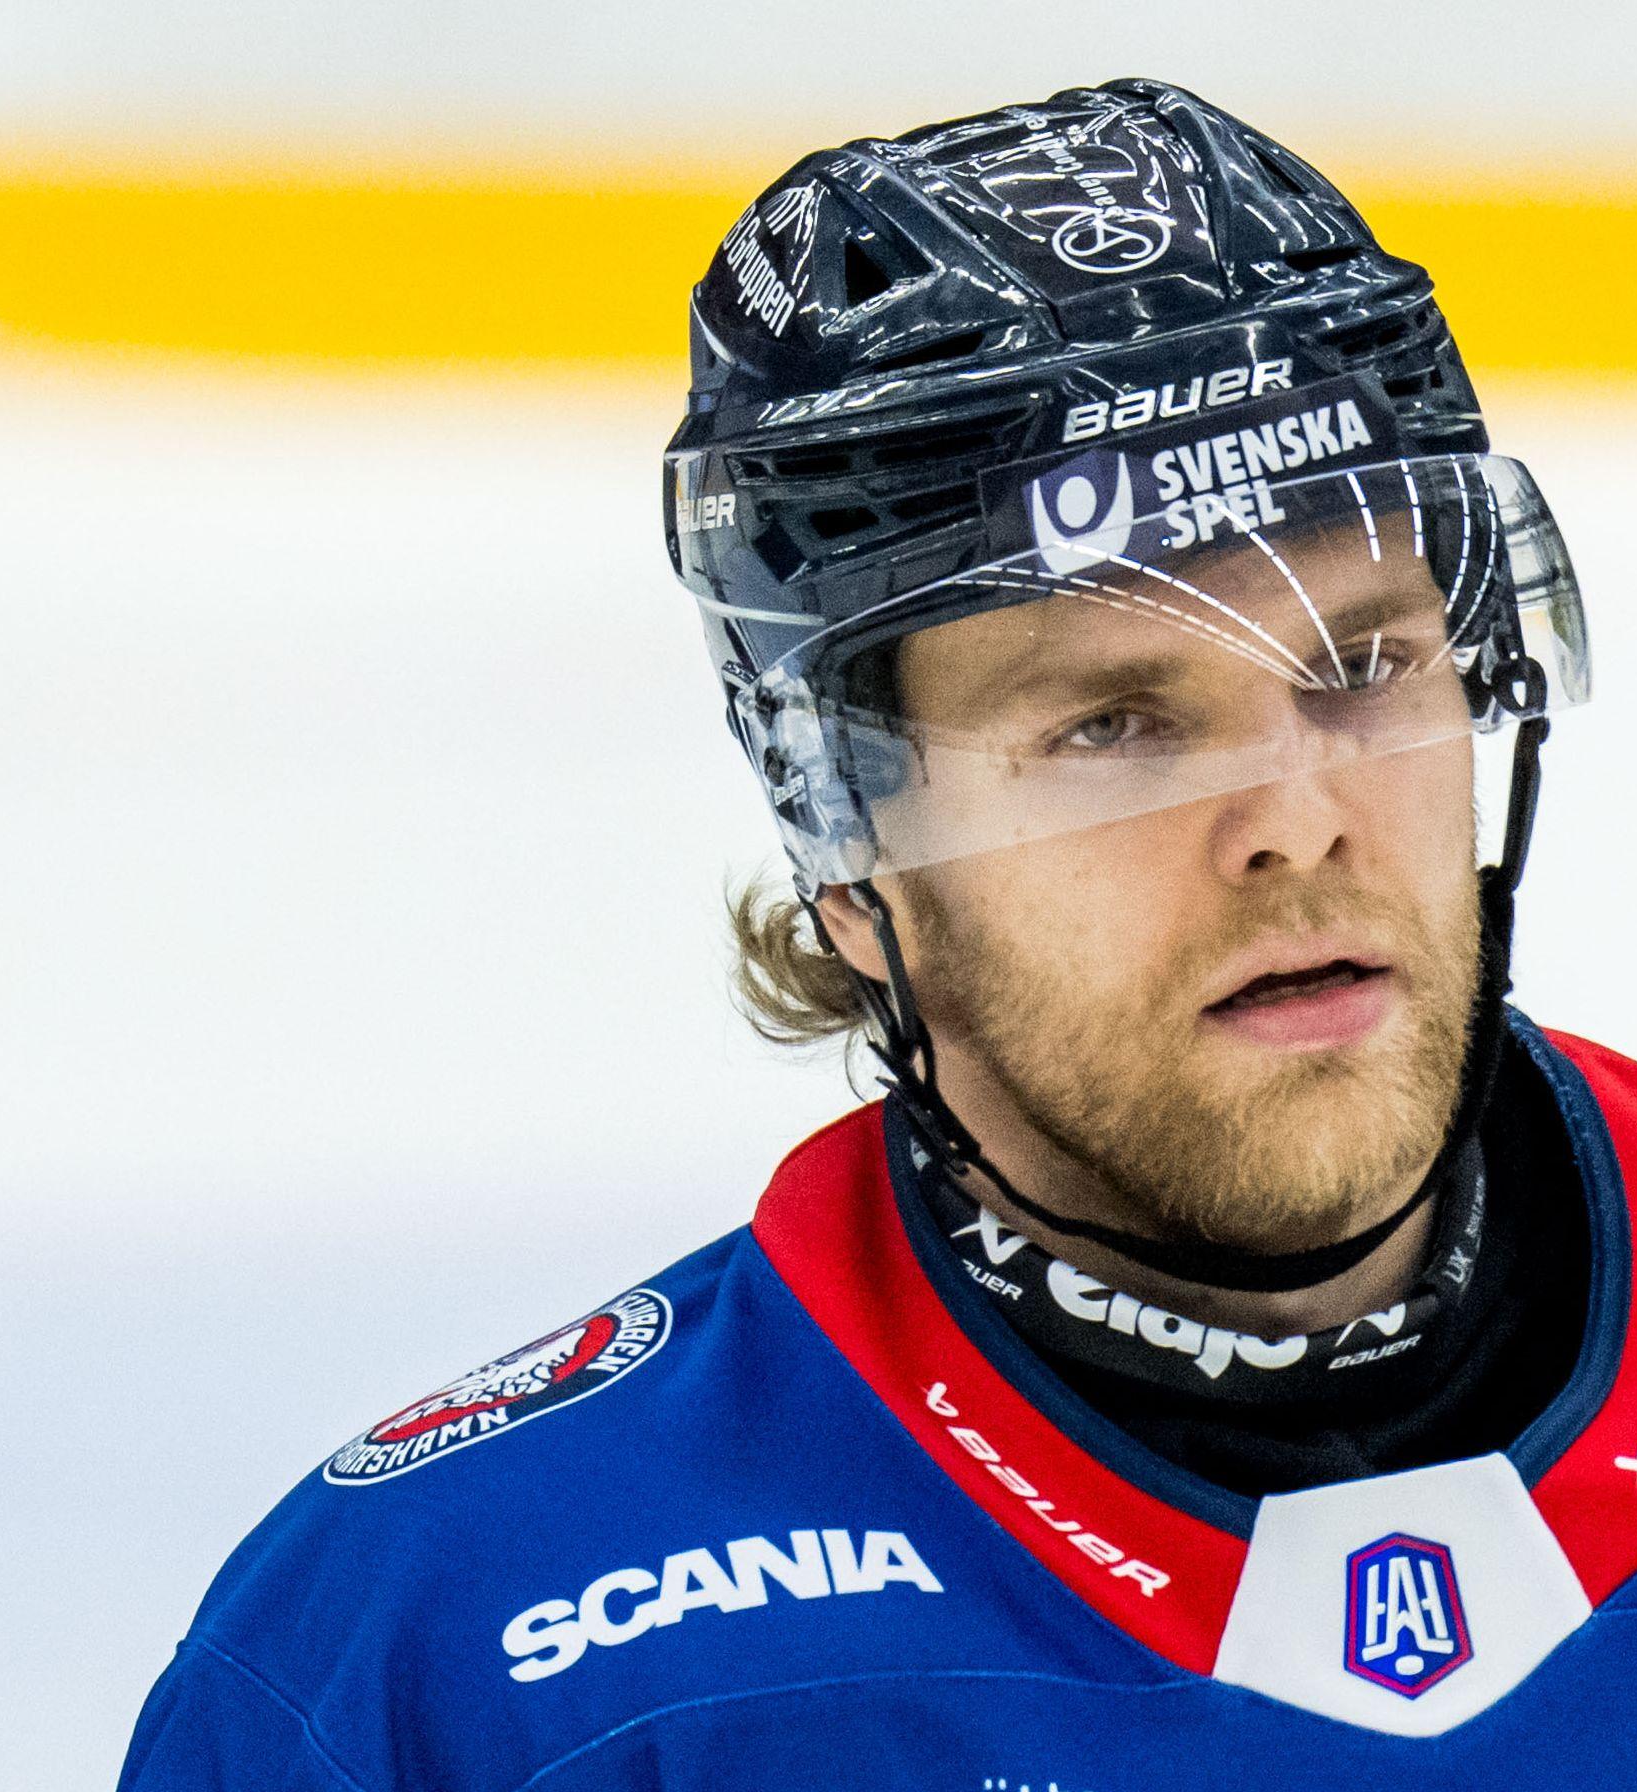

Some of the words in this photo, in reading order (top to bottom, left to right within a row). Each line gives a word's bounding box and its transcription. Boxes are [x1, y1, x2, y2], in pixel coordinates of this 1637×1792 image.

[726, 215, 795, 338] Gruppen
[1151, 399, 1373, 501] SVENSKA
[1164, 479, 1286, 549] SPEL
[501, 1528, 944, 1683] SCANIA
